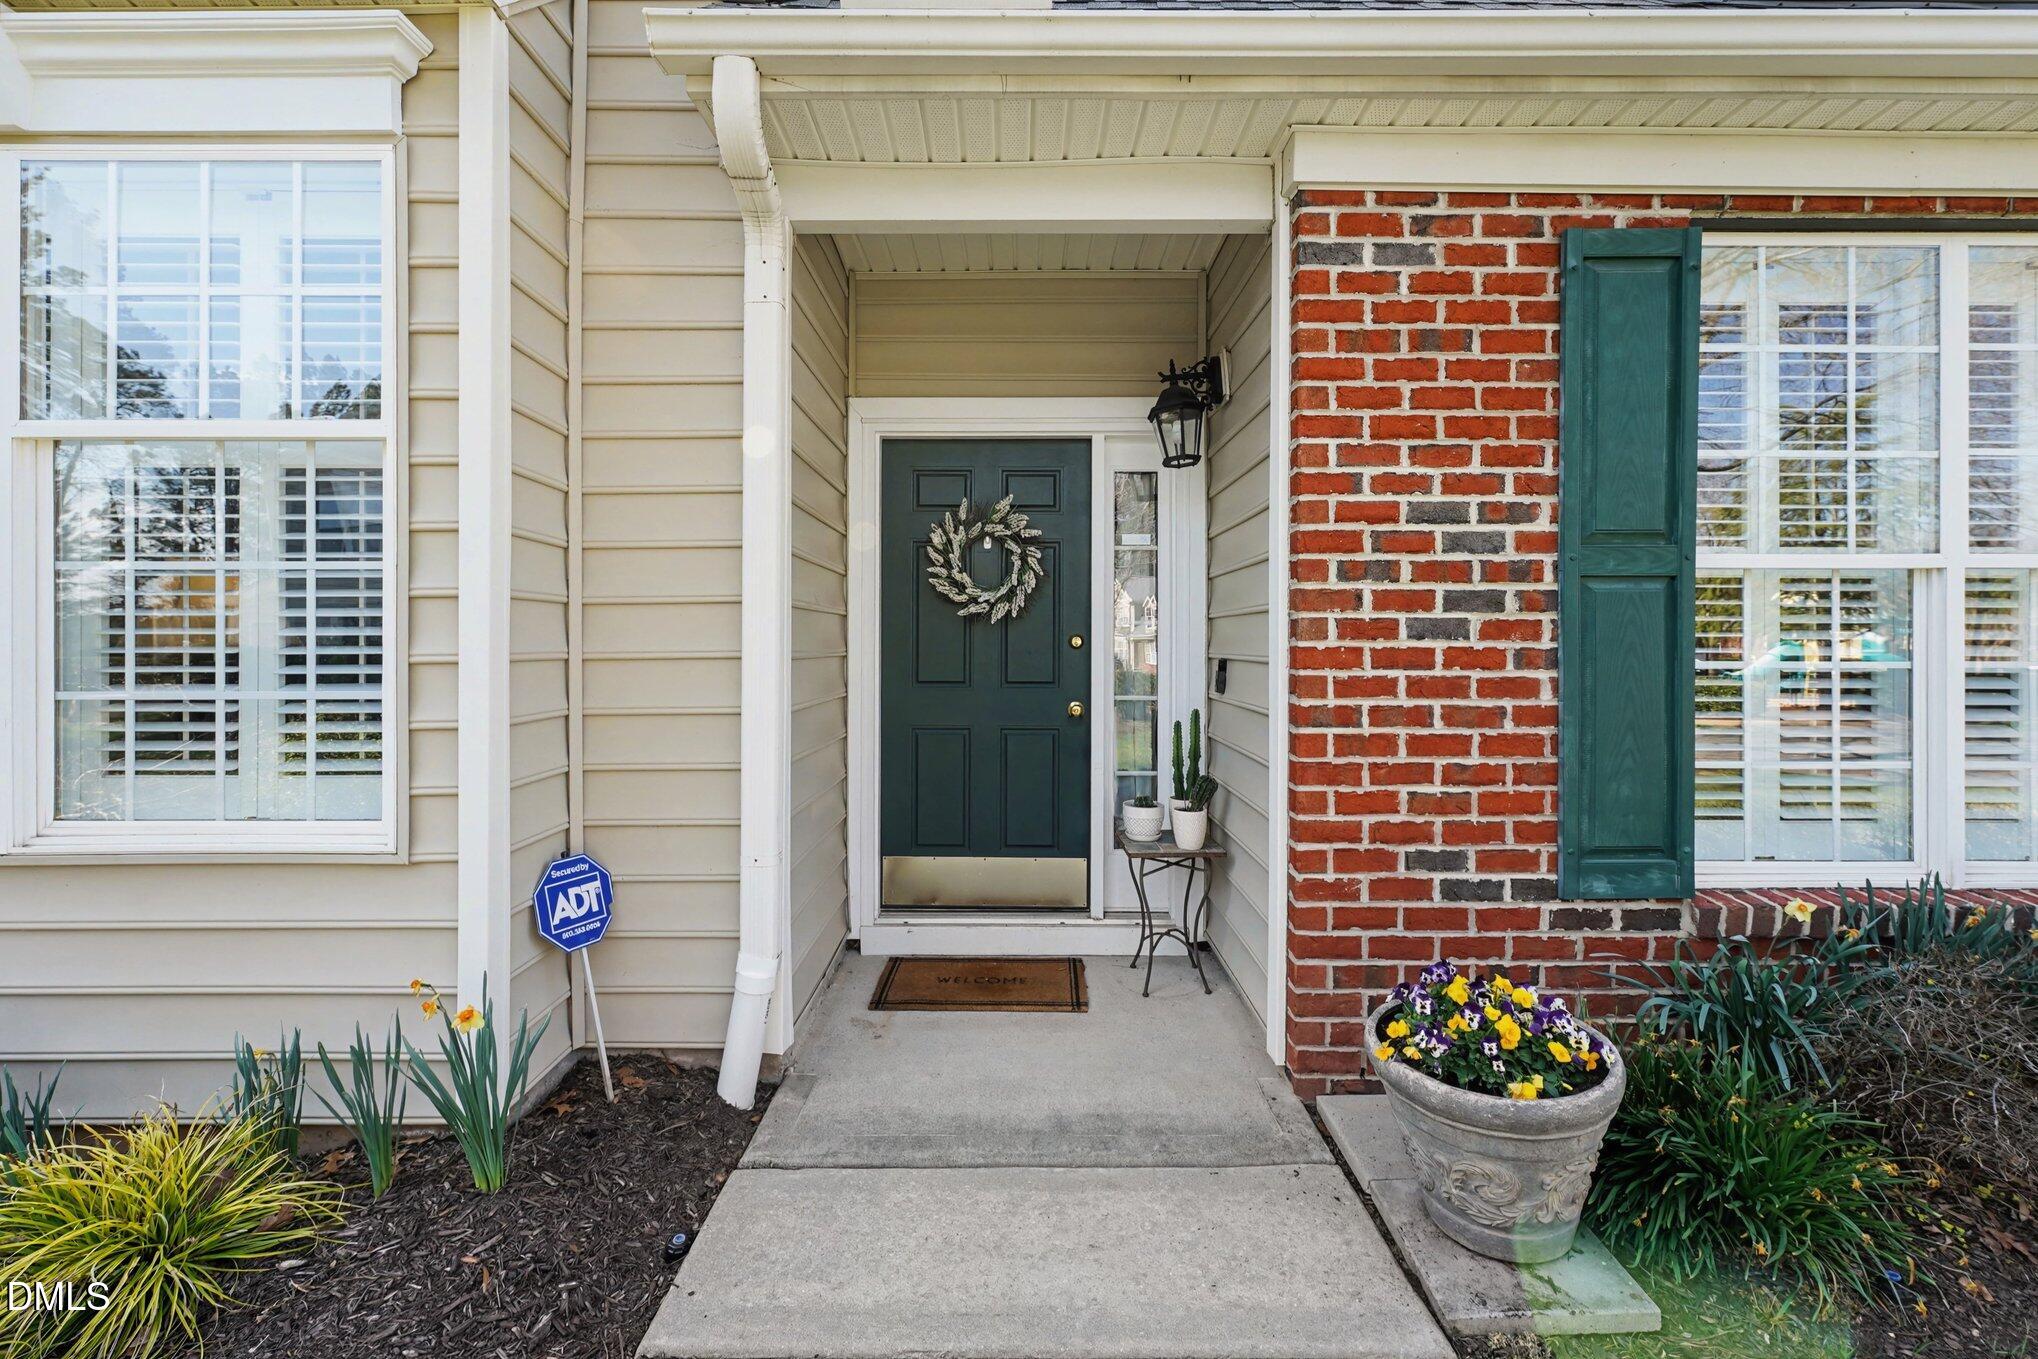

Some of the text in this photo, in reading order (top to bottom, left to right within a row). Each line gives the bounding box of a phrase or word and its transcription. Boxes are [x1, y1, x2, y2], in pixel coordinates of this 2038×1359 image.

[551, 863, 580, 878] Secured
[552, 880, 601, 925] ADT
[936, 975, 1028, 985] WELCOME
